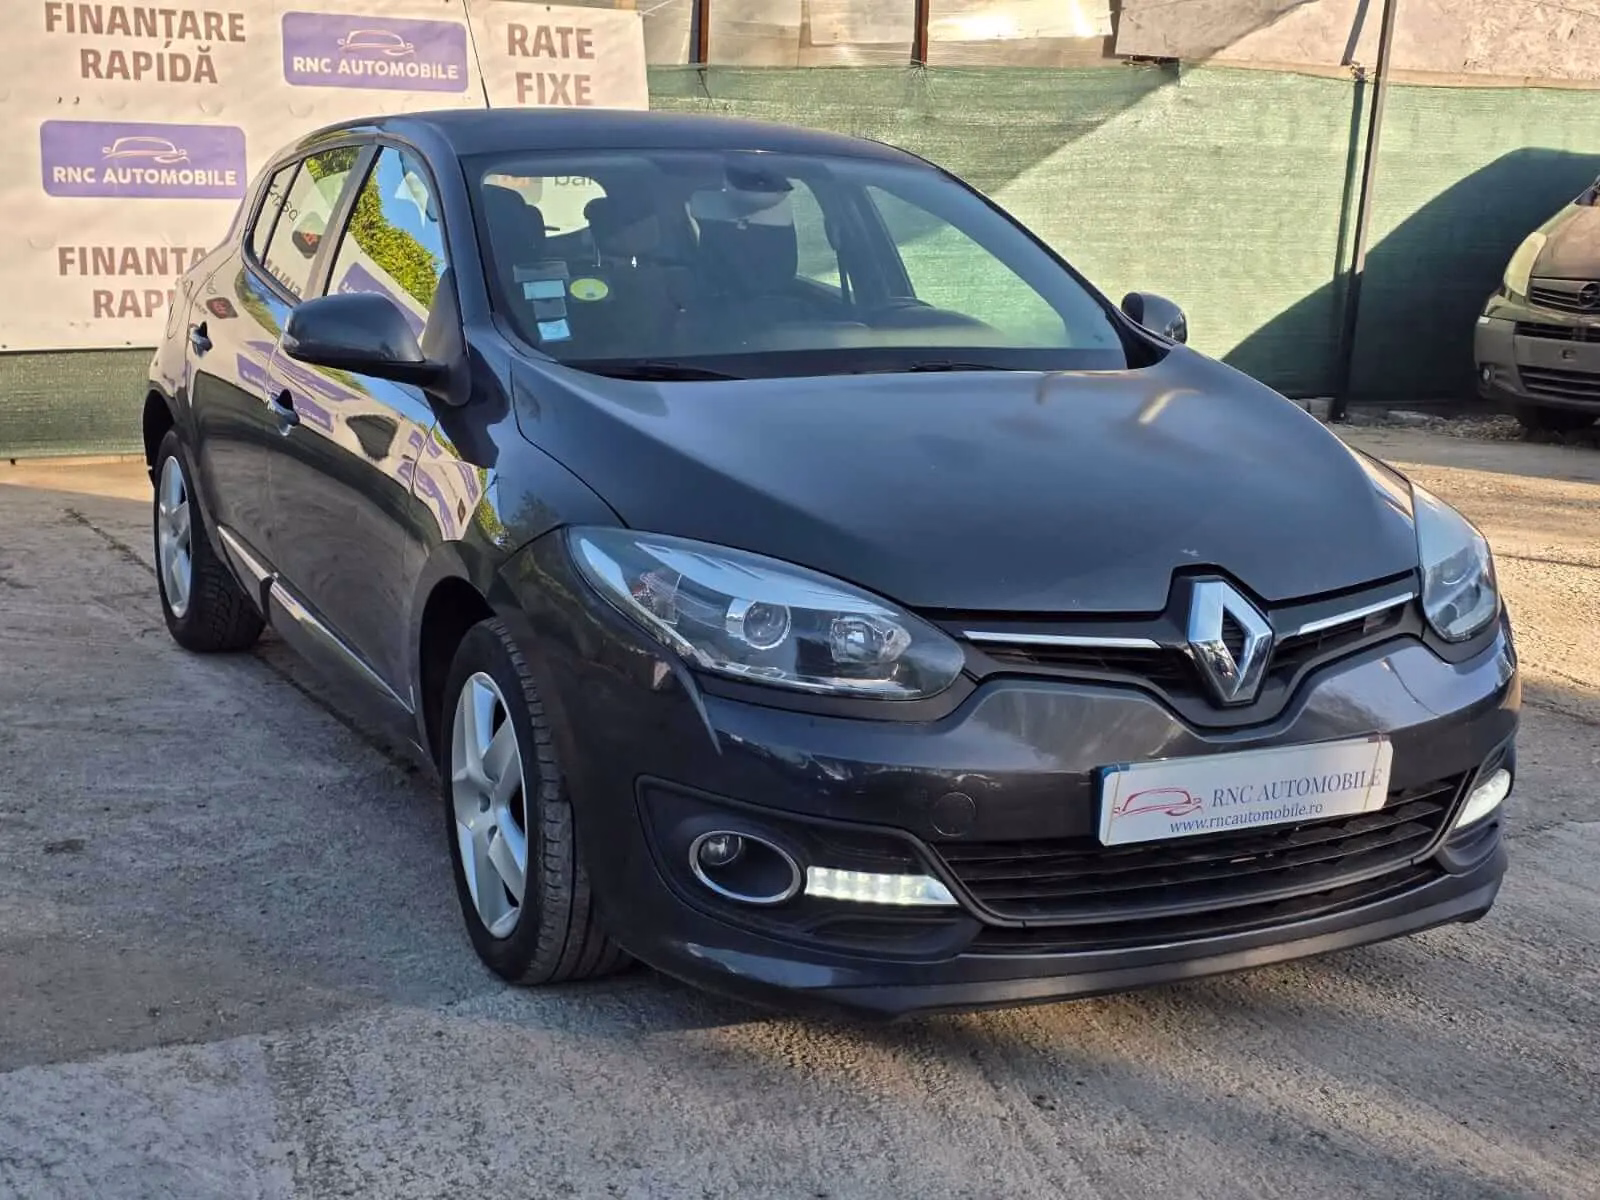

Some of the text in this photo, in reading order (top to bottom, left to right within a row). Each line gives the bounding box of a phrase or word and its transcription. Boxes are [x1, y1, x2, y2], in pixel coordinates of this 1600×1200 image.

[507, 23, 596, 60] RATE
[292, 56, 460, 80] RNC AUTOMOBILE
[515, 72, 594, 106] FIXE
[53, 166, 237, 186] RNC AUTOMOBILE
[1211, 768, 1383, 808] RNC AUTOMOBILE
[1169, 802, 1324, 834] www.rncautomobile.ro
